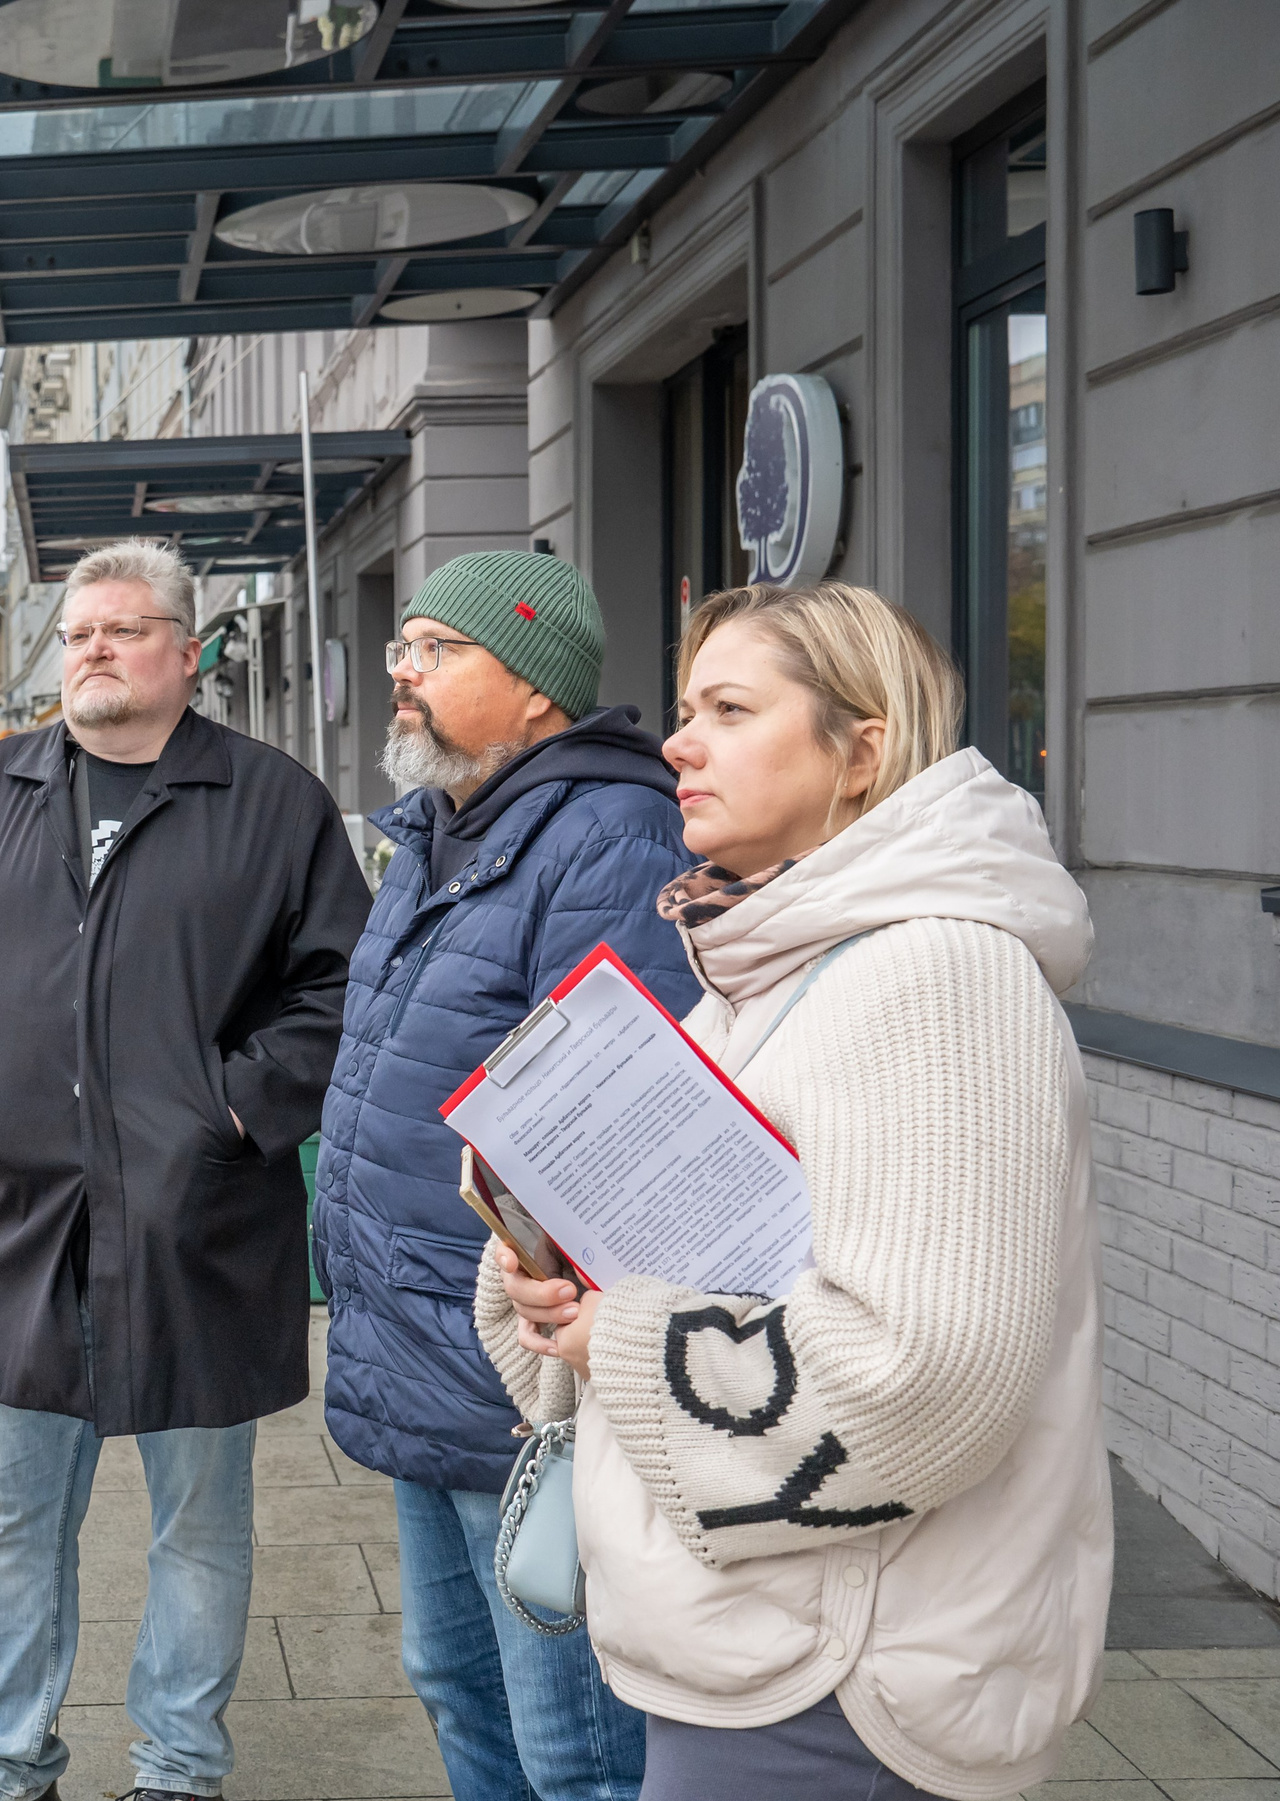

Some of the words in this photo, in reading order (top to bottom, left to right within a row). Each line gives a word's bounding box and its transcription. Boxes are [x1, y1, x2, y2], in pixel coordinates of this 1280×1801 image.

[496, 1094, 525, 1123] Бульварное
[541, 1052, 568, 1079] Никитский
[570, 1026, 594, 1051] Тверской
[592, 1004, 618, 1030] бульвары
